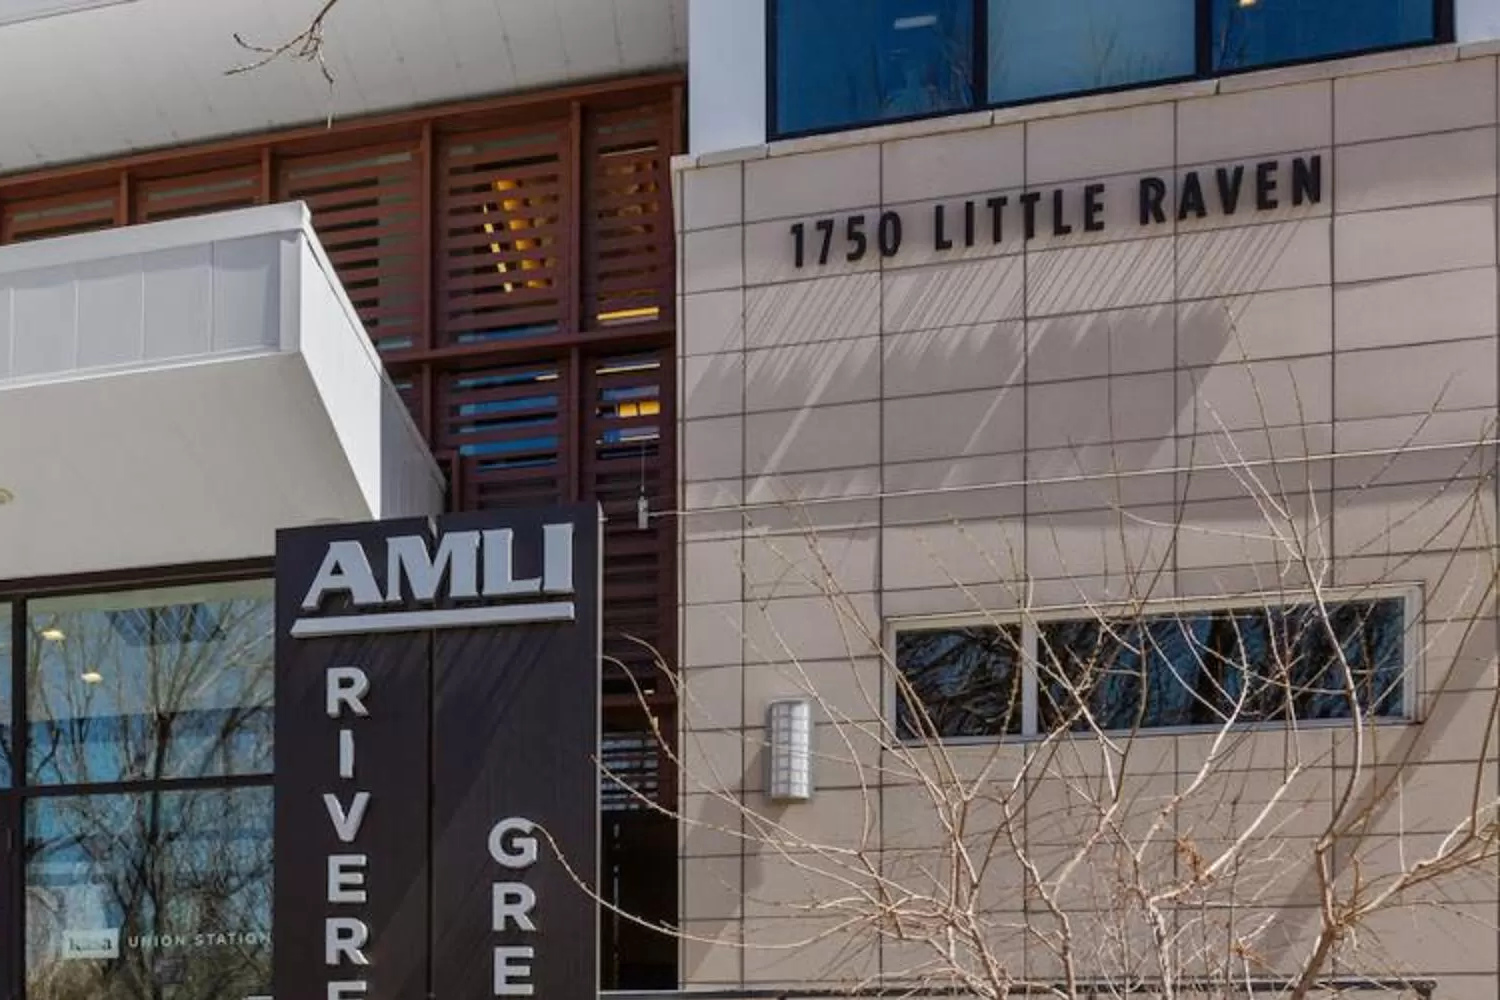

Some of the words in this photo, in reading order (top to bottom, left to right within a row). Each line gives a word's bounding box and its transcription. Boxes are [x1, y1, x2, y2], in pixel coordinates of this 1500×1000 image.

[790, 213, 901, 267] 1750
[935, 185, 1105, 250] LITTLE
[1139, 155, 1323, 226] RAVEN
[301, 522, 575, 610] AMLI
[128, 935, 185, 948] UNION
